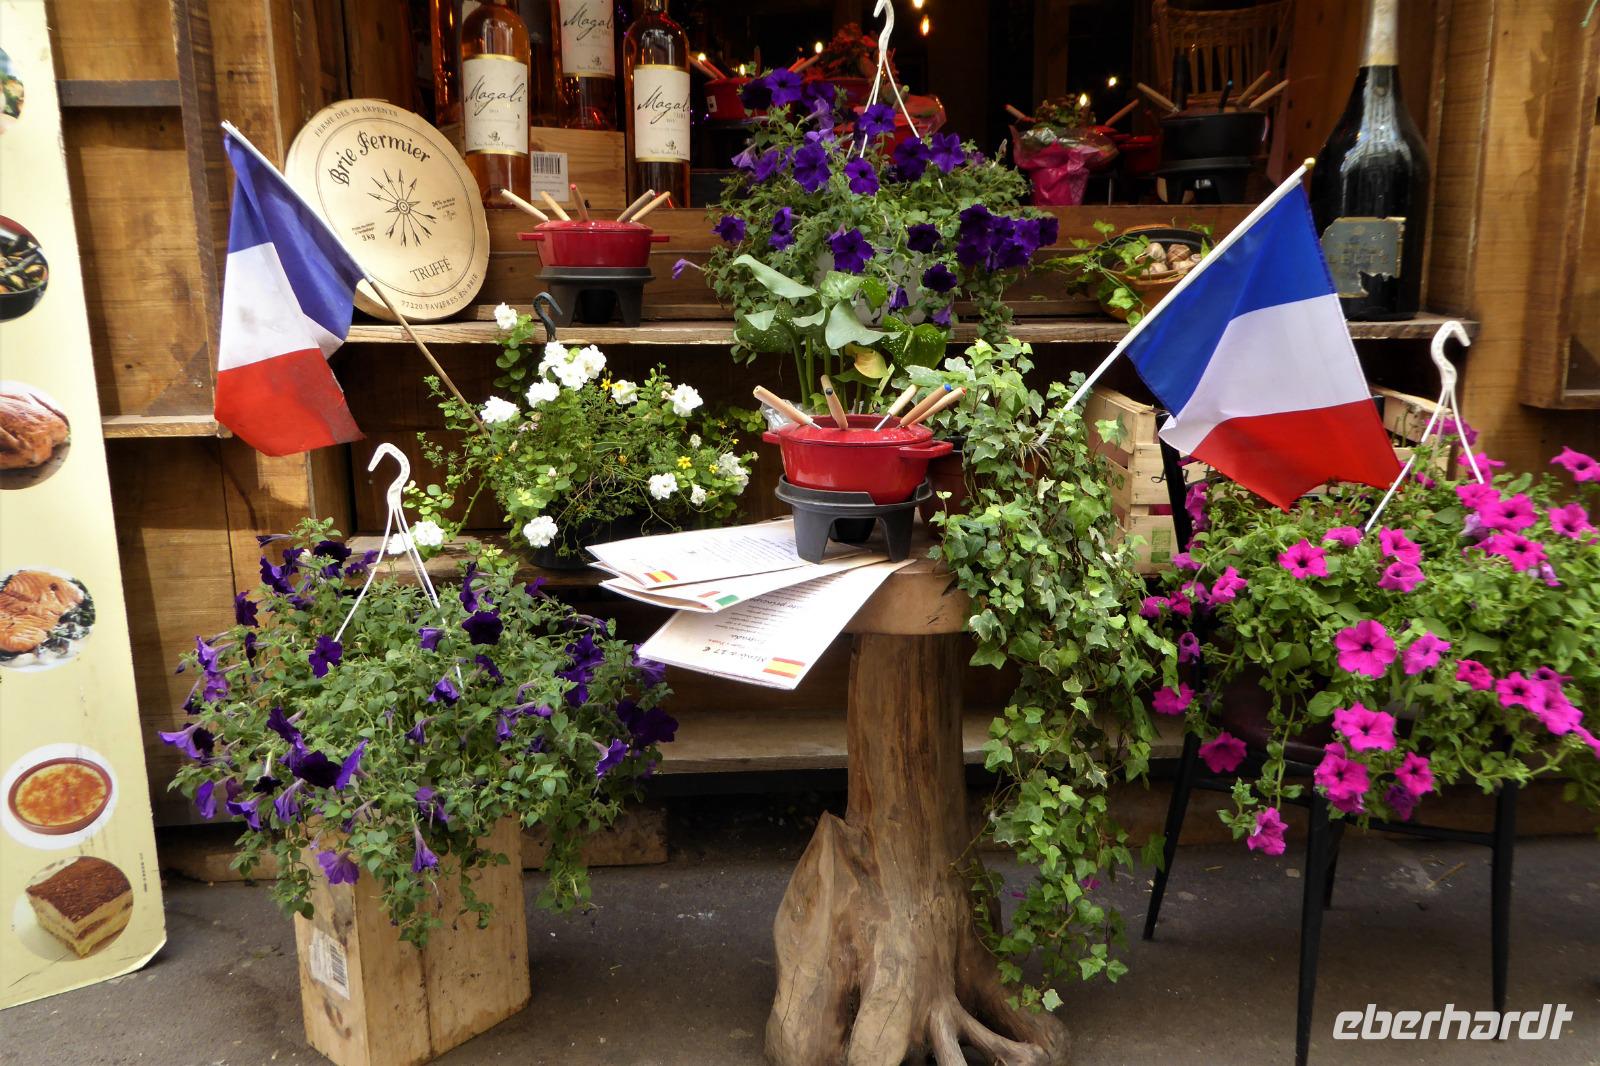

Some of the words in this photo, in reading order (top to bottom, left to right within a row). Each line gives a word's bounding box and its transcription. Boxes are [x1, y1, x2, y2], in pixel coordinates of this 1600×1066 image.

[465, 74, 526, 117] Magali
[314, 116, 337, 138] FERME
[328, 148, 358, 187] Brie
[357, 130, 431, 163] Fermier
[409, 257, 452, 282] TRUFFÉ
